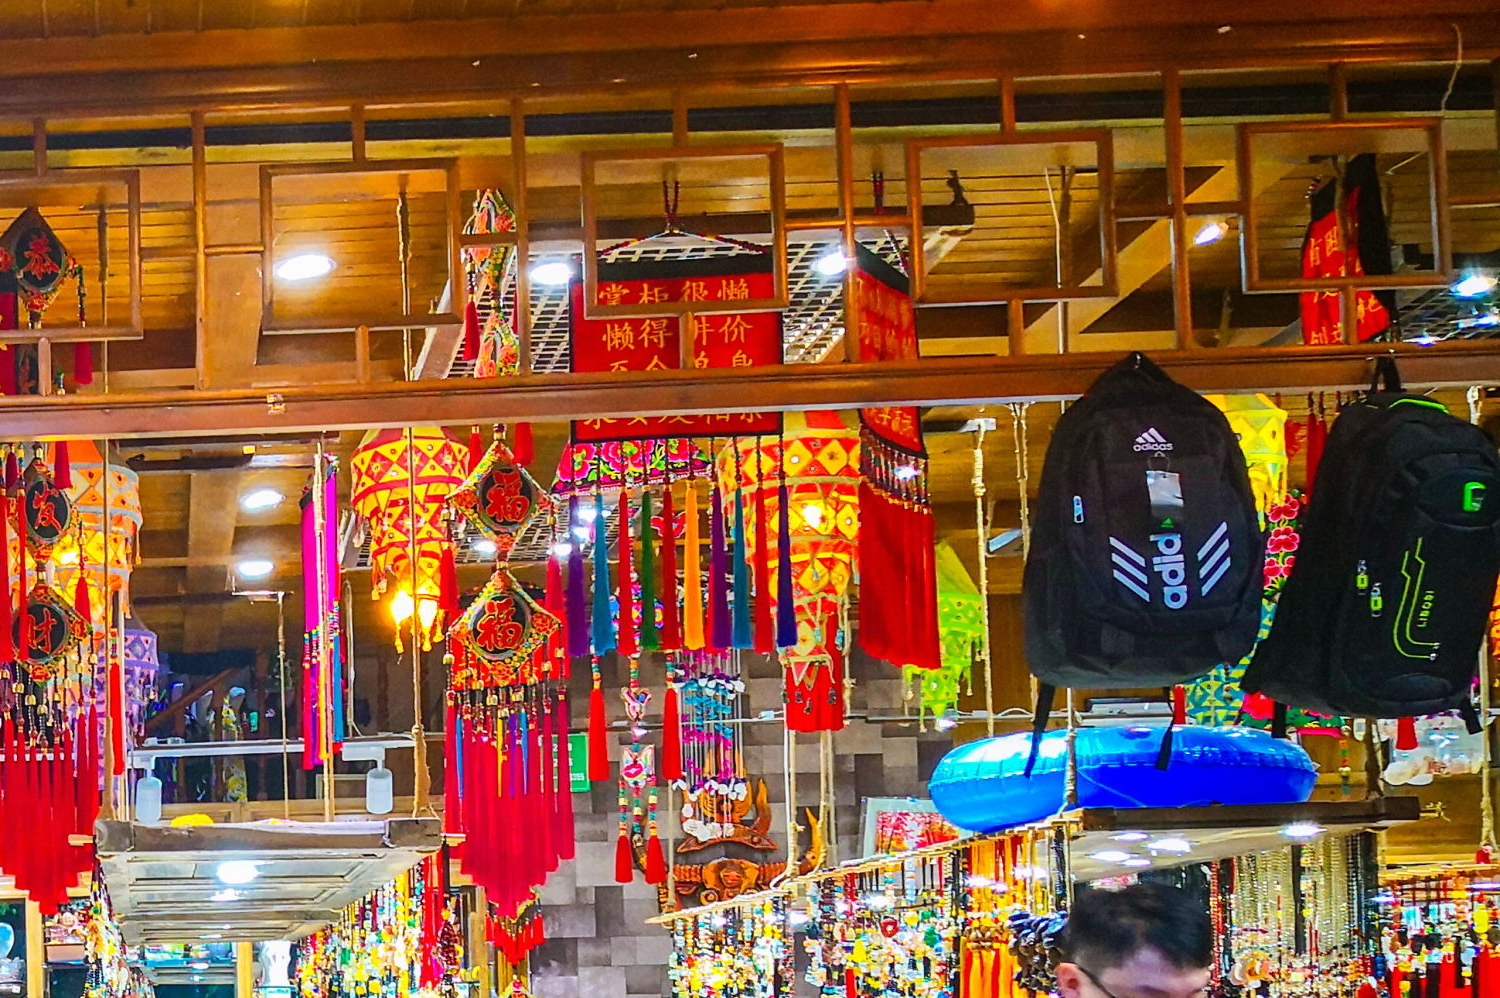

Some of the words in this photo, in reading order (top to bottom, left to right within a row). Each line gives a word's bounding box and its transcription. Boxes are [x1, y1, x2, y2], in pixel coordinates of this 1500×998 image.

[1133, 442, 1174, 452] adidas
[486, 470, 530, 522] 福
[1150, 533, 1188, 609] adid
[476, 598, 523, 651] 福
